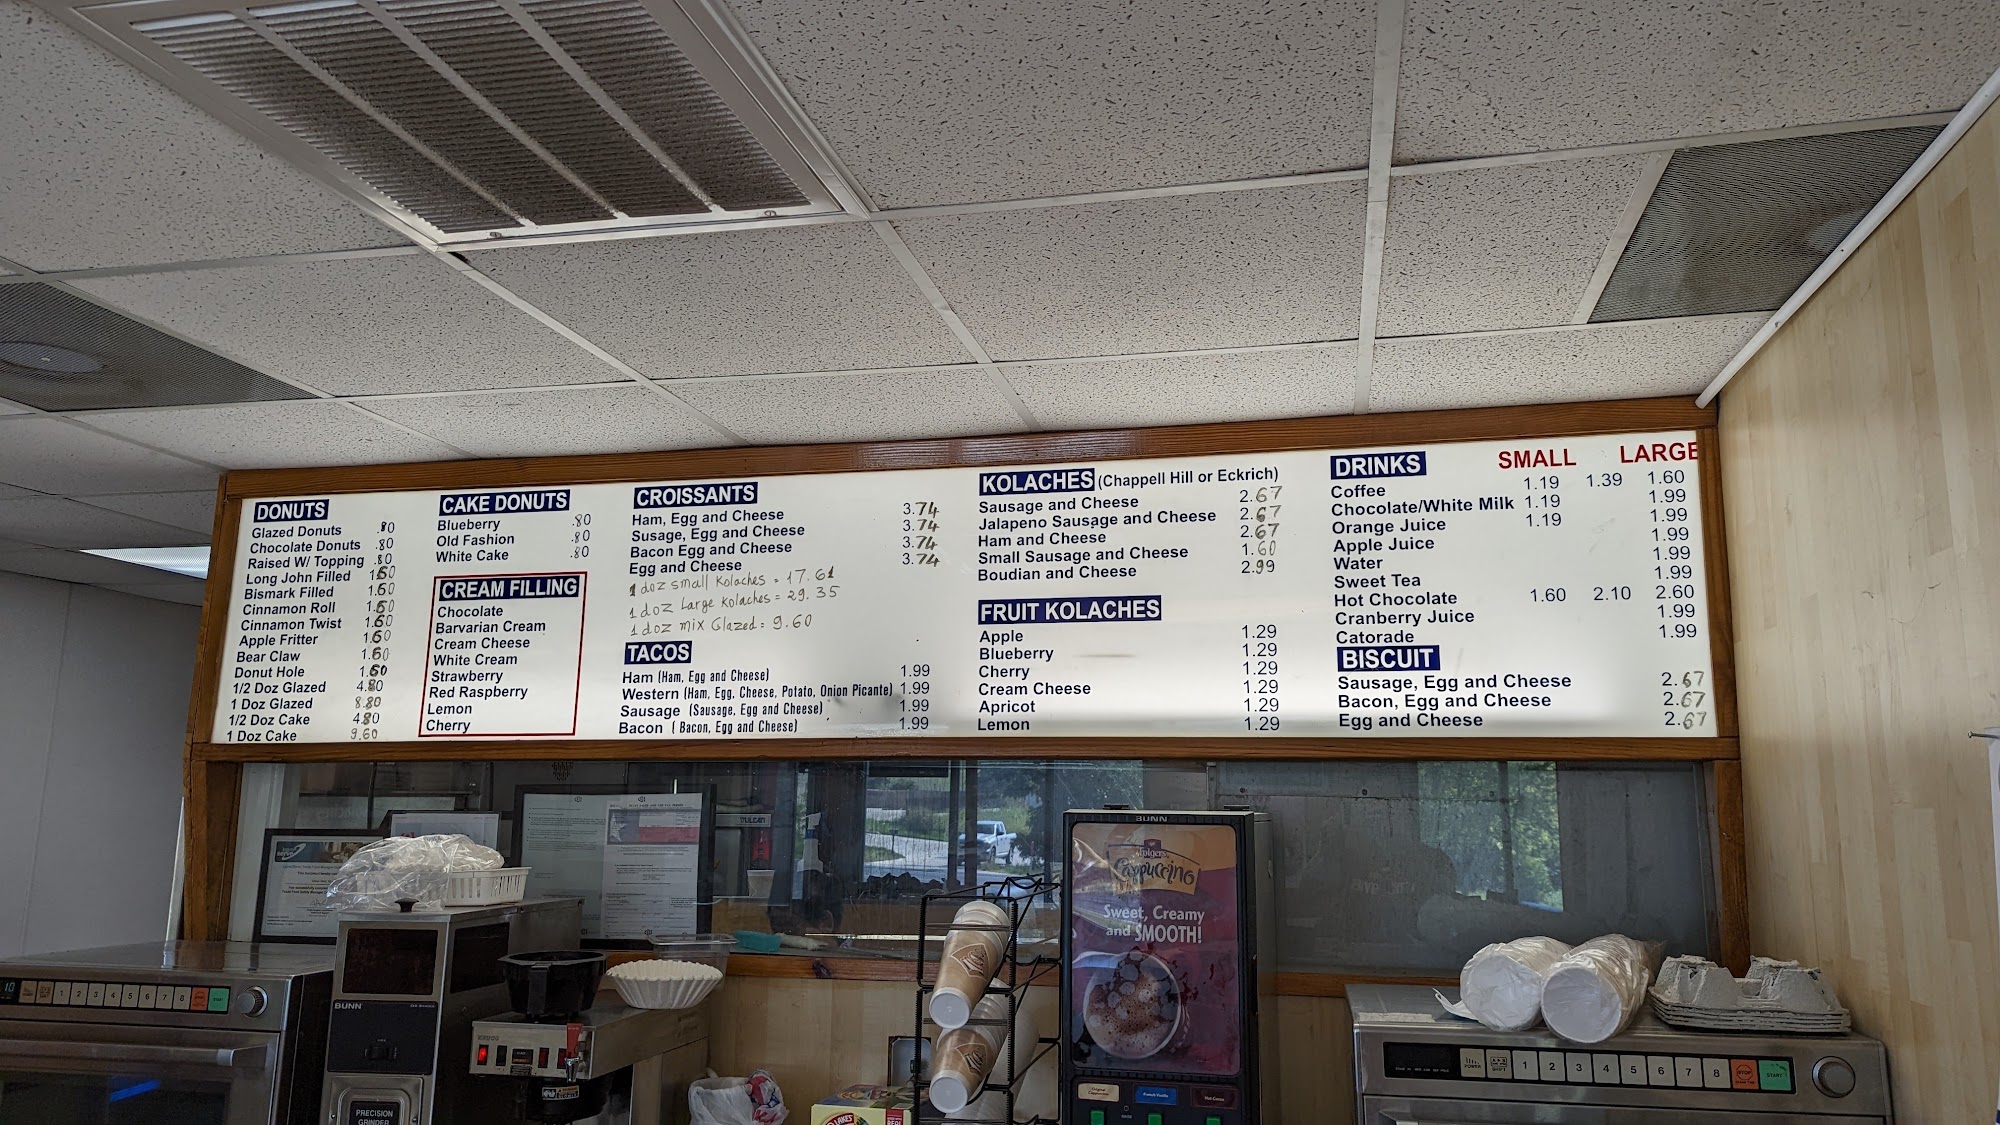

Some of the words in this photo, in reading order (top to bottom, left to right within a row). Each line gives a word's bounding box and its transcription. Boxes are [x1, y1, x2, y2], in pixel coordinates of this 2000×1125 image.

[1336, 454, 1421, 477] DRINKS
[1498, 448, 1577, 469] SMALL
[1620, 442, 1698, 463] LARGE
[983, 471, 1093, 493] KOLACHES
[1098, 472, 1165, 491] (Chappell
[1170, 470, 1193, 484] Hill
[1198, 473, 1213, 483] or
[1218, 466, 1278, 483] Eckrich)
[1331, 484, 1386, 499] Coffee
[1524, 475, 1559, 490] 1.19
[1586, 472, 1622, 487] 1.39
[1648, 470, 1685, 484] 1.60
[443, 496, 490, 513] CAKE
[495, 492, 567, 511] DONUTS
[637, 485, 754, 506] CROISSANTS
[1331, 498, 1473, 516] Chocolate/White
[1479, 496, 1514, 510] Milk
[1525, 494, 1560, 508] 1.19
[1649, 488, 1686, 503] 1.99
[257, 502, 325, 520] DONUTS
[437, 518, 500, 532] Blueberry
[979, 517, 1047, 532] Jalapeno
[1052, 515, 1118, 529] Sausage
[1123, 511, 1152, 525] and
[1157, 510, 1216, 523] Cheese
[252, 526, 294, 539] Glazed
[298, 525, 342, 537] Donuts
[632, 530, 686, 544] Susage,
[691, 527, 717, 542] Egg
[722, 526, 748, 538] and
[752, 525, 805, 537] Cheese
[246, 573, 278, 587] Long
[281, 572, 312, 584] John
[316, 570, 351, 582] Filled
[978, 567, 1040, 581] Boudian
[1046, 566, 1073, 579] and
[1079, 565, 1137, 578] Cheese
[442, 580, 505, 599] CREAM
[510, 578, 577, 596] FILLING
[1334, 594, 1364, 607] Hot
[1369, 591, 1457, 606] Chocolate
[1530, 588, 1566, 602] 1.60
[1593, 586, 1631, 601] 2.10
[1656, 584, 1694, 599] 2.60
[243, 604, 306, 616] Cinnamon
[310, 601, 336, 614] Roll
[437, 605, 503, 618] Chocolate
[981, 603, 1040, 621] FRUIT
[1046, 599, 1160, 620] KOLACHES
[435, 621, 498, 635] Barvarian
[502, 620, 547, 633] Cream
[1336, 630, 1414, 644] Catorade
[1659, 623, 1697, 638] 1.99
[239, 634, 275, 649] Apple
[280, 633, 318, 645] Fritter
[628, 643, 689, 662] TACOS
[980, 647, 1054, 662] Blueberry
[1242, 642, 1277, 657] 1.29
[1343, 648, 1434, 669] BISCUIT
[234, 667, 273, 678] Donut
[276, 666, 305, 678] Hole
[431, 670, 503, 684] Strawberry
[254, 682, 279, 694] Doz
[283, 681, 326, 693] Glazed
[622, 688, 679, 700] Western
[820, 684, 848, 697] Onion
[852, 682, 893, 697] Picante)
[900, 681, 930, 695] 1.99
[1338, 676, 1417, 693] Sausage,
[1424, 675, 1458, 692] Egg
[1465, 674, 1497, 688] and
[1503, 674, 1571, 688] Cheese
[620, 705, 680, 720] Sausage
[740, 703, 758, 717] Egg
[762, 703, 779, 715] and
[783, 701, 823, 715] Cheese)
[900, 699, 929, 712] 1.99
[237, 730, 262, 742] Doz
[267, 730, 297, 742] Cake
[739, 816, 766, 824] VULCAN
[1136, 848, 1167, 858] Folgers
[1113, 857, 1195, 885] Cappuccino
[1103, 904, 1148, 922] Sweet,
[1152, 905, 1205, 925] Creamy
[1106, 925, 1131, 937] and
[1134, 924, 1203, 944] SMOOTH!
[355, 1109, 394, 1118] PRECISION
[833, 1114, 853, 1125] LAKES
